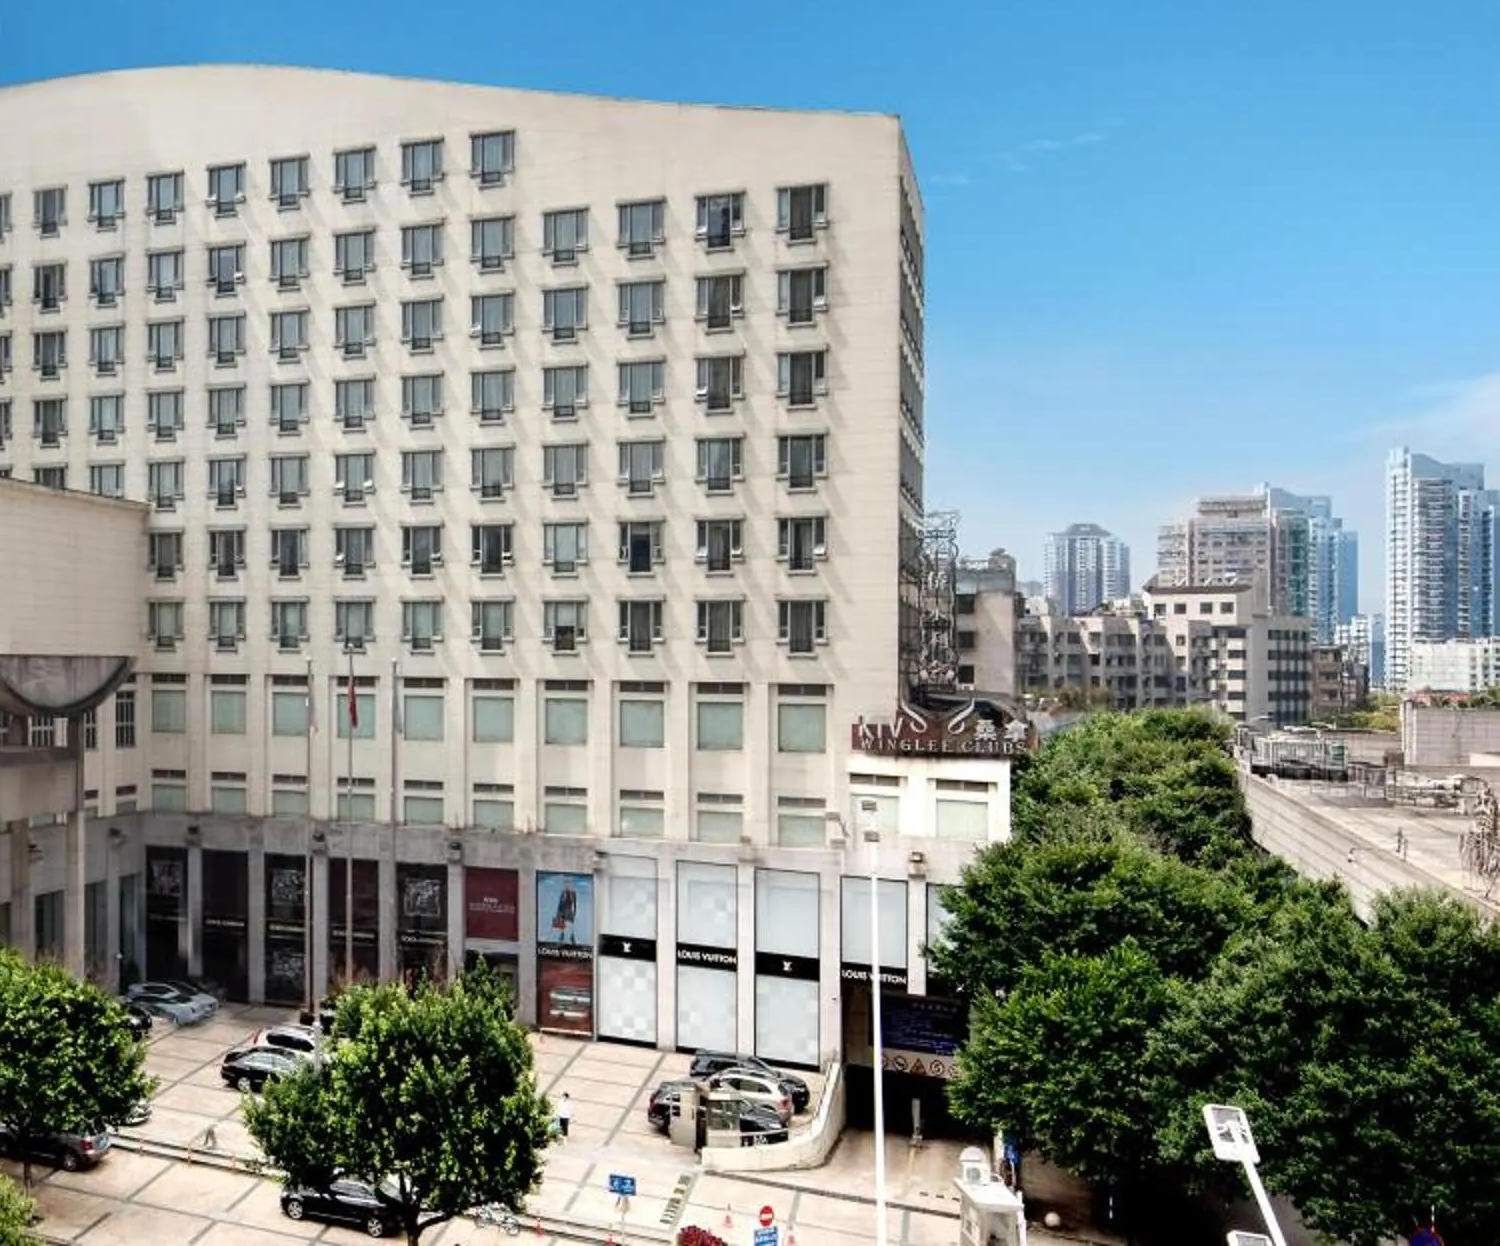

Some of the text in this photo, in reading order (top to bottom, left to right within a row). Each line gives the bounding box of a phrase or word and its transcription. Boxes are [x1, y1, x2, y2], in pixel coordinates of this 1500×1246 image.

[677, 949, 737, 965] LOUIS VUITTON
[841, 969, 867, 981] LOUIS
